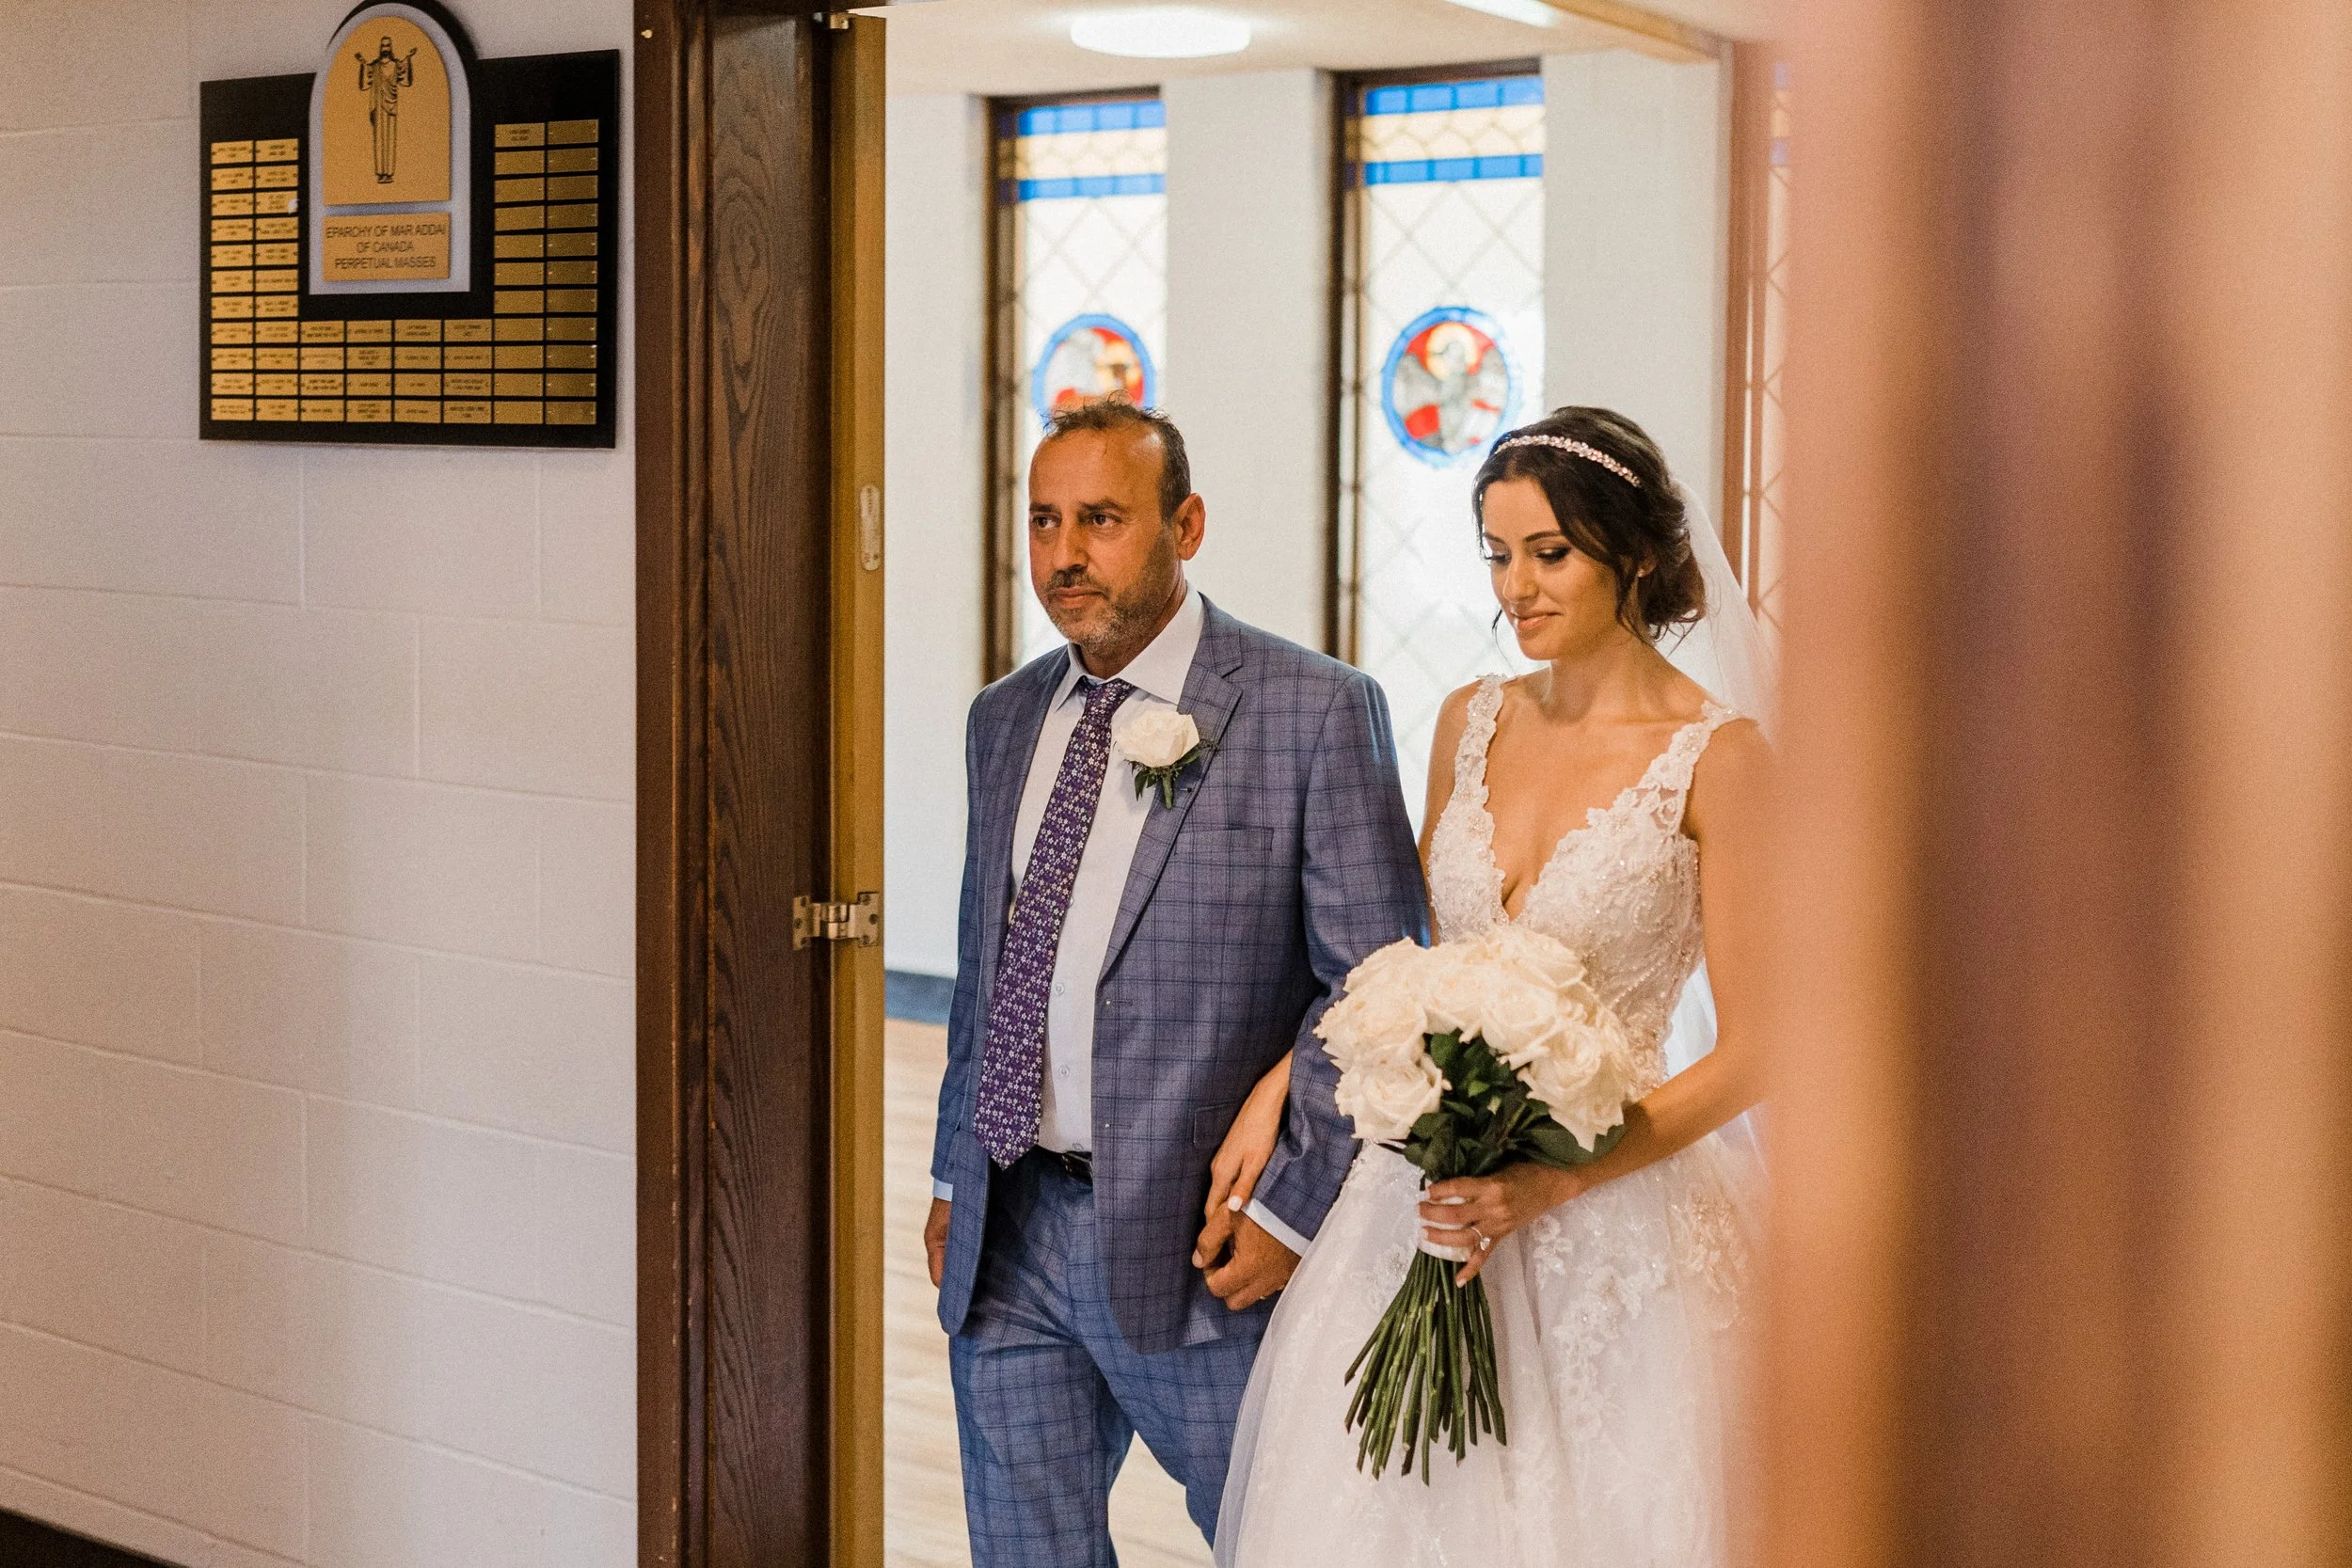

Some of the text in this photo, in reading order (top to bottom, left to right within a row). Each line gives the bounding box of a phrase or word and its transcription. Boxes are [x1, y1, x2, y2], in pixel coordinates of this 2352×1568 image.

[326, 227, 372, 238] EPARCHY
[373, 226, 388, 237] OF
[391, 225, 412, 236] MAR
[358, 241, 413, 253] OF CANADA
[335, 256, 436, 269] PERPETUAL MASSES
